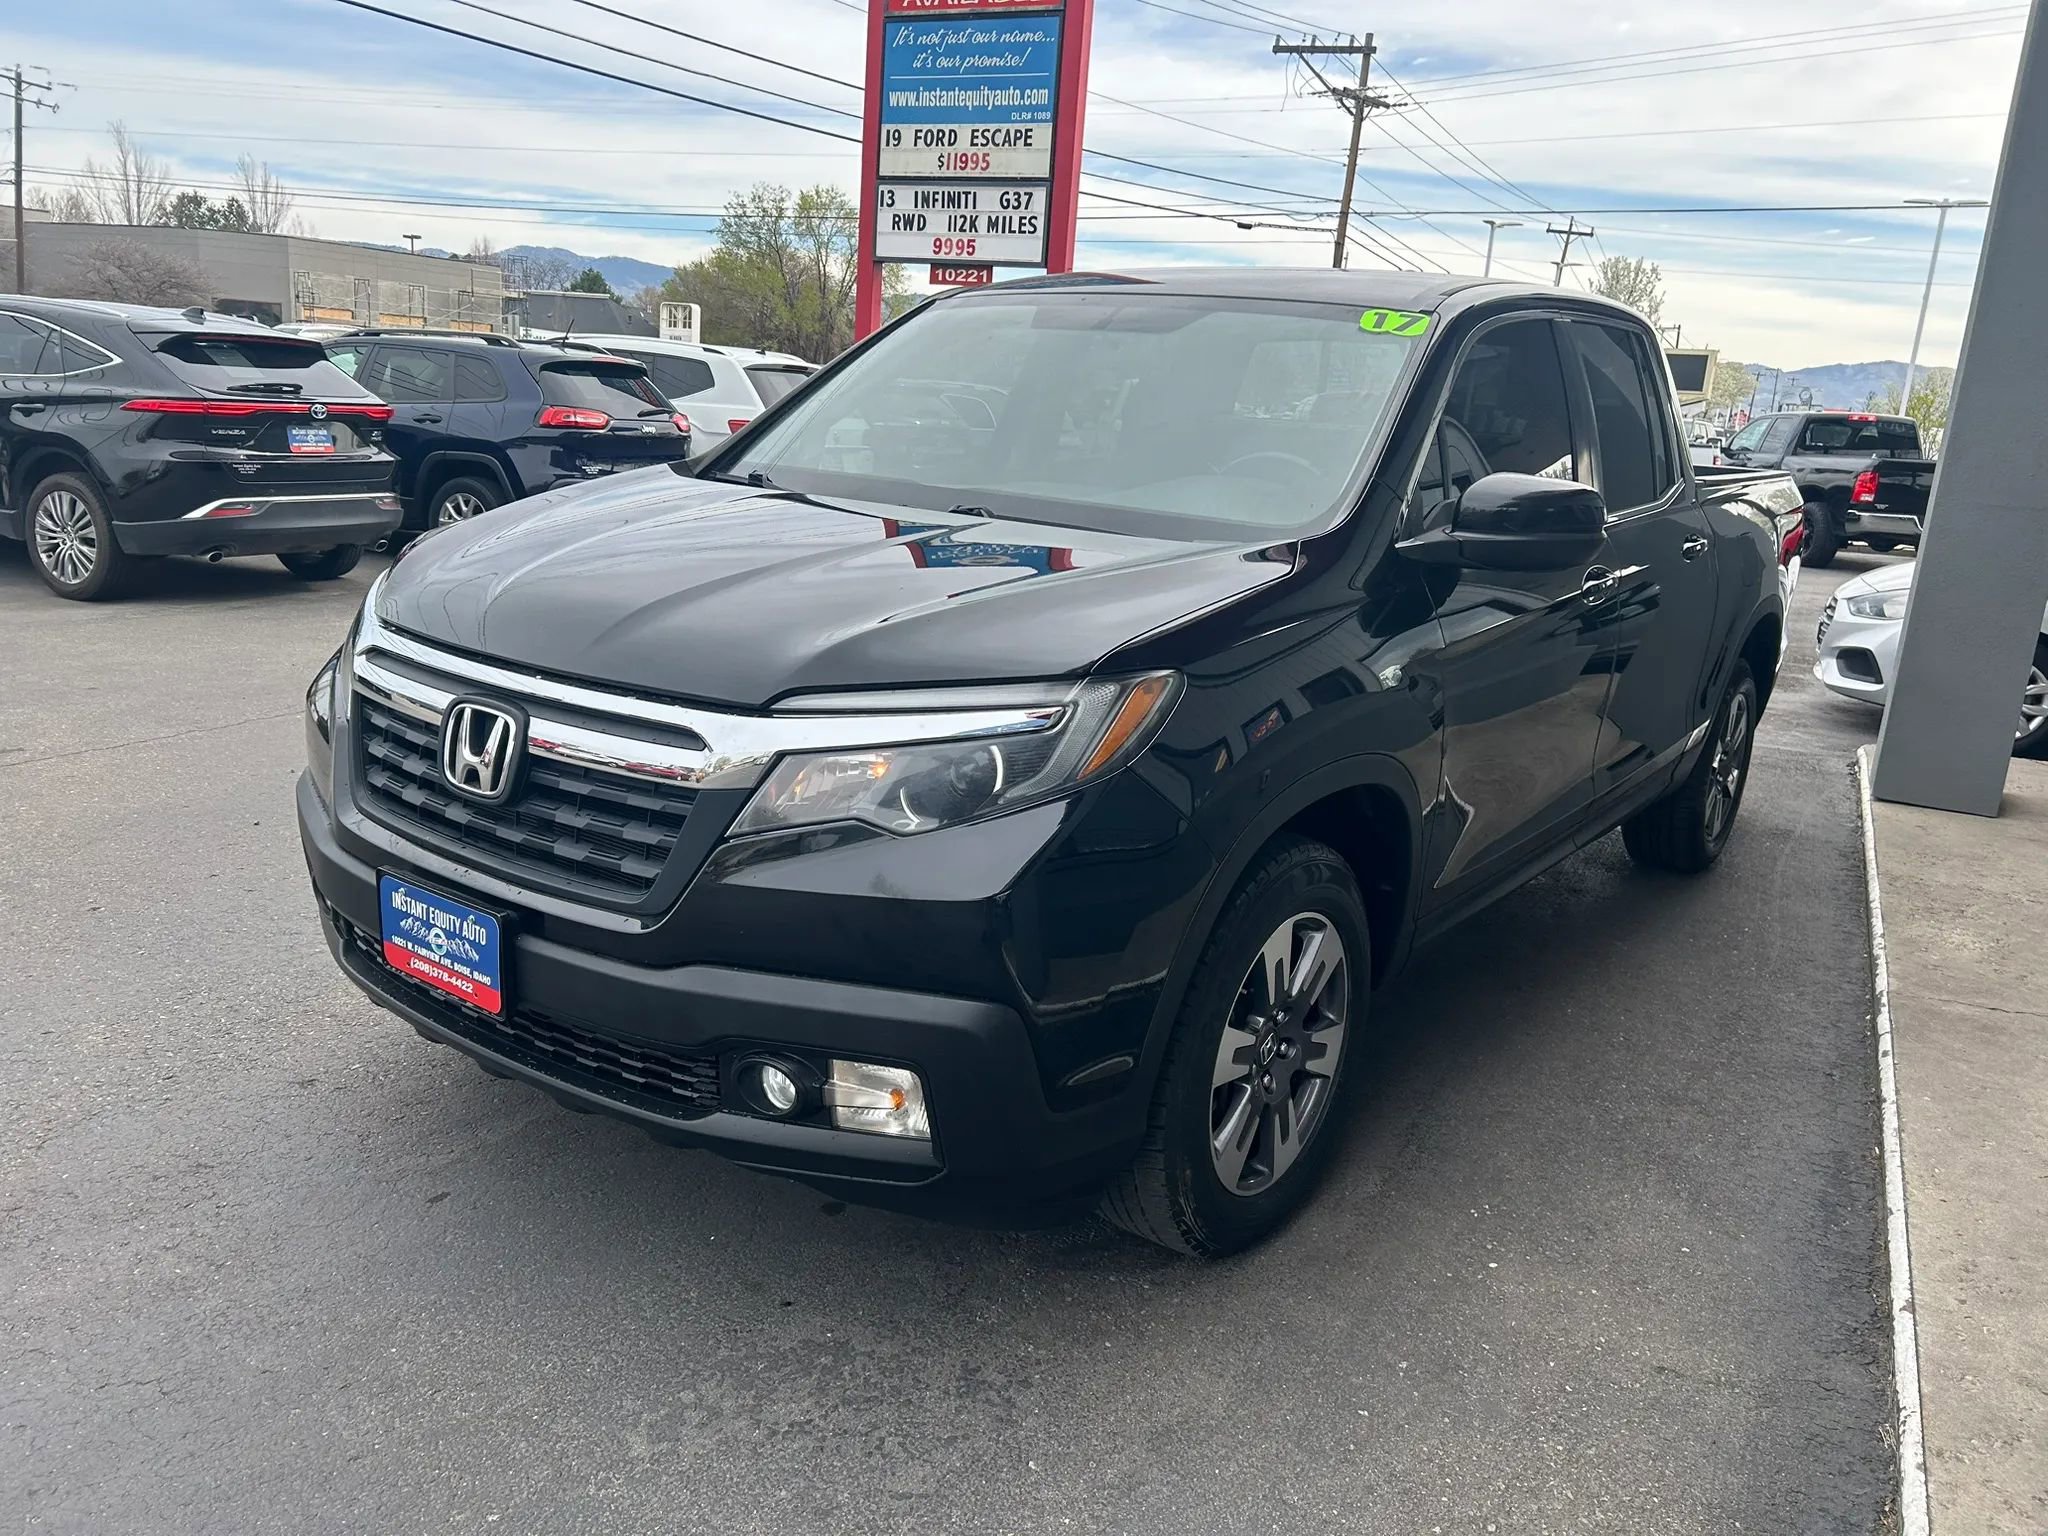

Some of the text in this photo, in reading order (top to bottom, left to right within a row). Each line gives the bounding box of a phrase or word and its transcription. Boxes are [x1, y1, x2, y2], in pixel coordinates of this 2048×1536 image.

[893, 26, 1055, 52] It's not just our name...
[912, 47, 1031, 74] it's our promise!
[889, 85, 1048, 111] www.instantequityauto.com
[1011, 111, 1051, 120] DLR# 1089
[885, 128, 1033, 147] 19 FORD ESCAPE
[938, 152, 991, 171] $11995
[879, 190, 1034, 210] 13 INFINITI G37
[892, 213, 1038, 234] RWD 112K MILES
[932, 237, 976, 256] 9995
[935, 268, 988, 283] 10221
[1372, 312, 1426, 331] 17
[641, 424, 656, 434] Jeep
[391, 891, 486, 946] INSTANT EQUITY AUTO
[414, 944, 440, 962] FAIRVIEW
[473, 970, 491, 986] IDAHO
